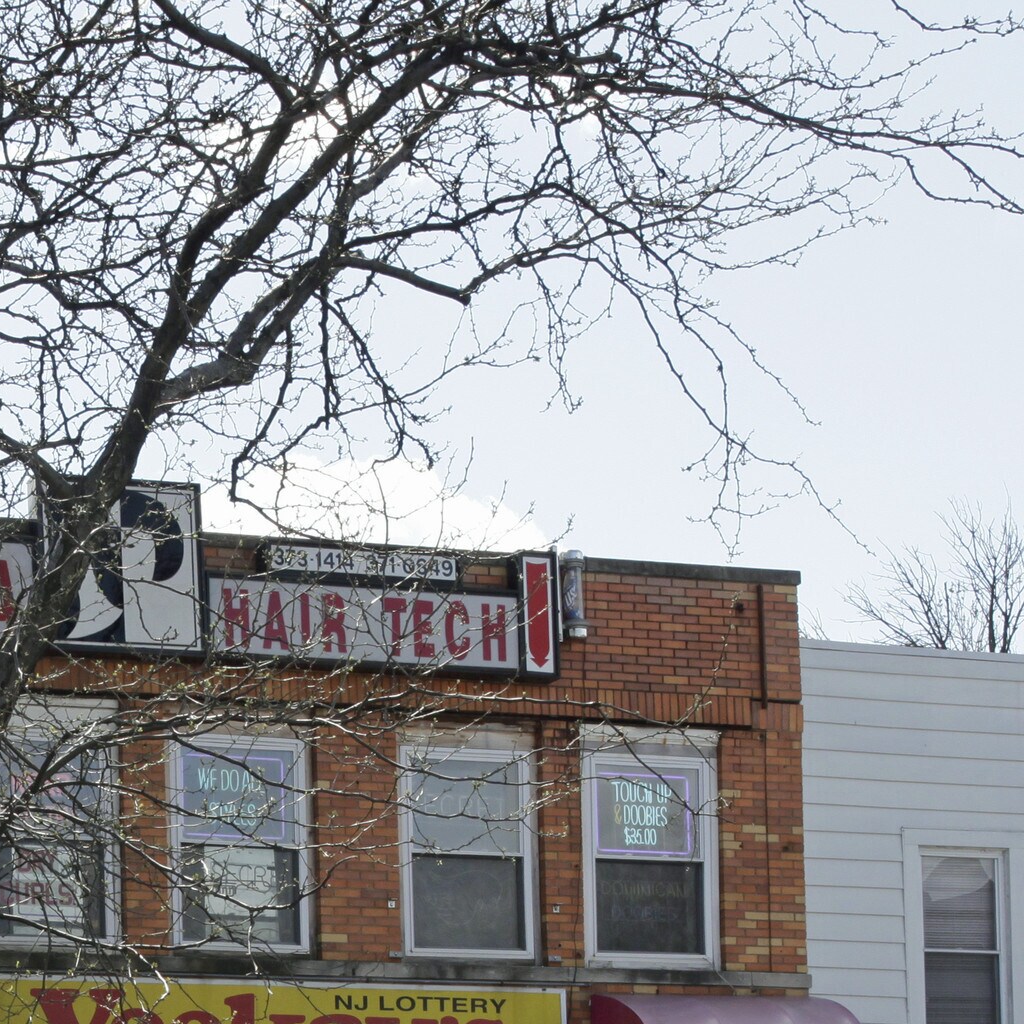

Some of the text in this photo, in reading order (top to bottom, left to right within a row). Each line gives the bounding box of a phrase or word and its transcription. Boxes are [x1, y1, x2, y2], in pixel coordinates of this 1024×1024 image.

[223, 588, 508, 662] HAIR TECH
[198, 768, 217, 790] WE
[221, 769, 240, 791] DO
[611, 782, 672, 804] TOUCH UP
[623, 805, 668, 827] DOOBIES
[334, 994, 507, 1015] NJ LOTTERY
